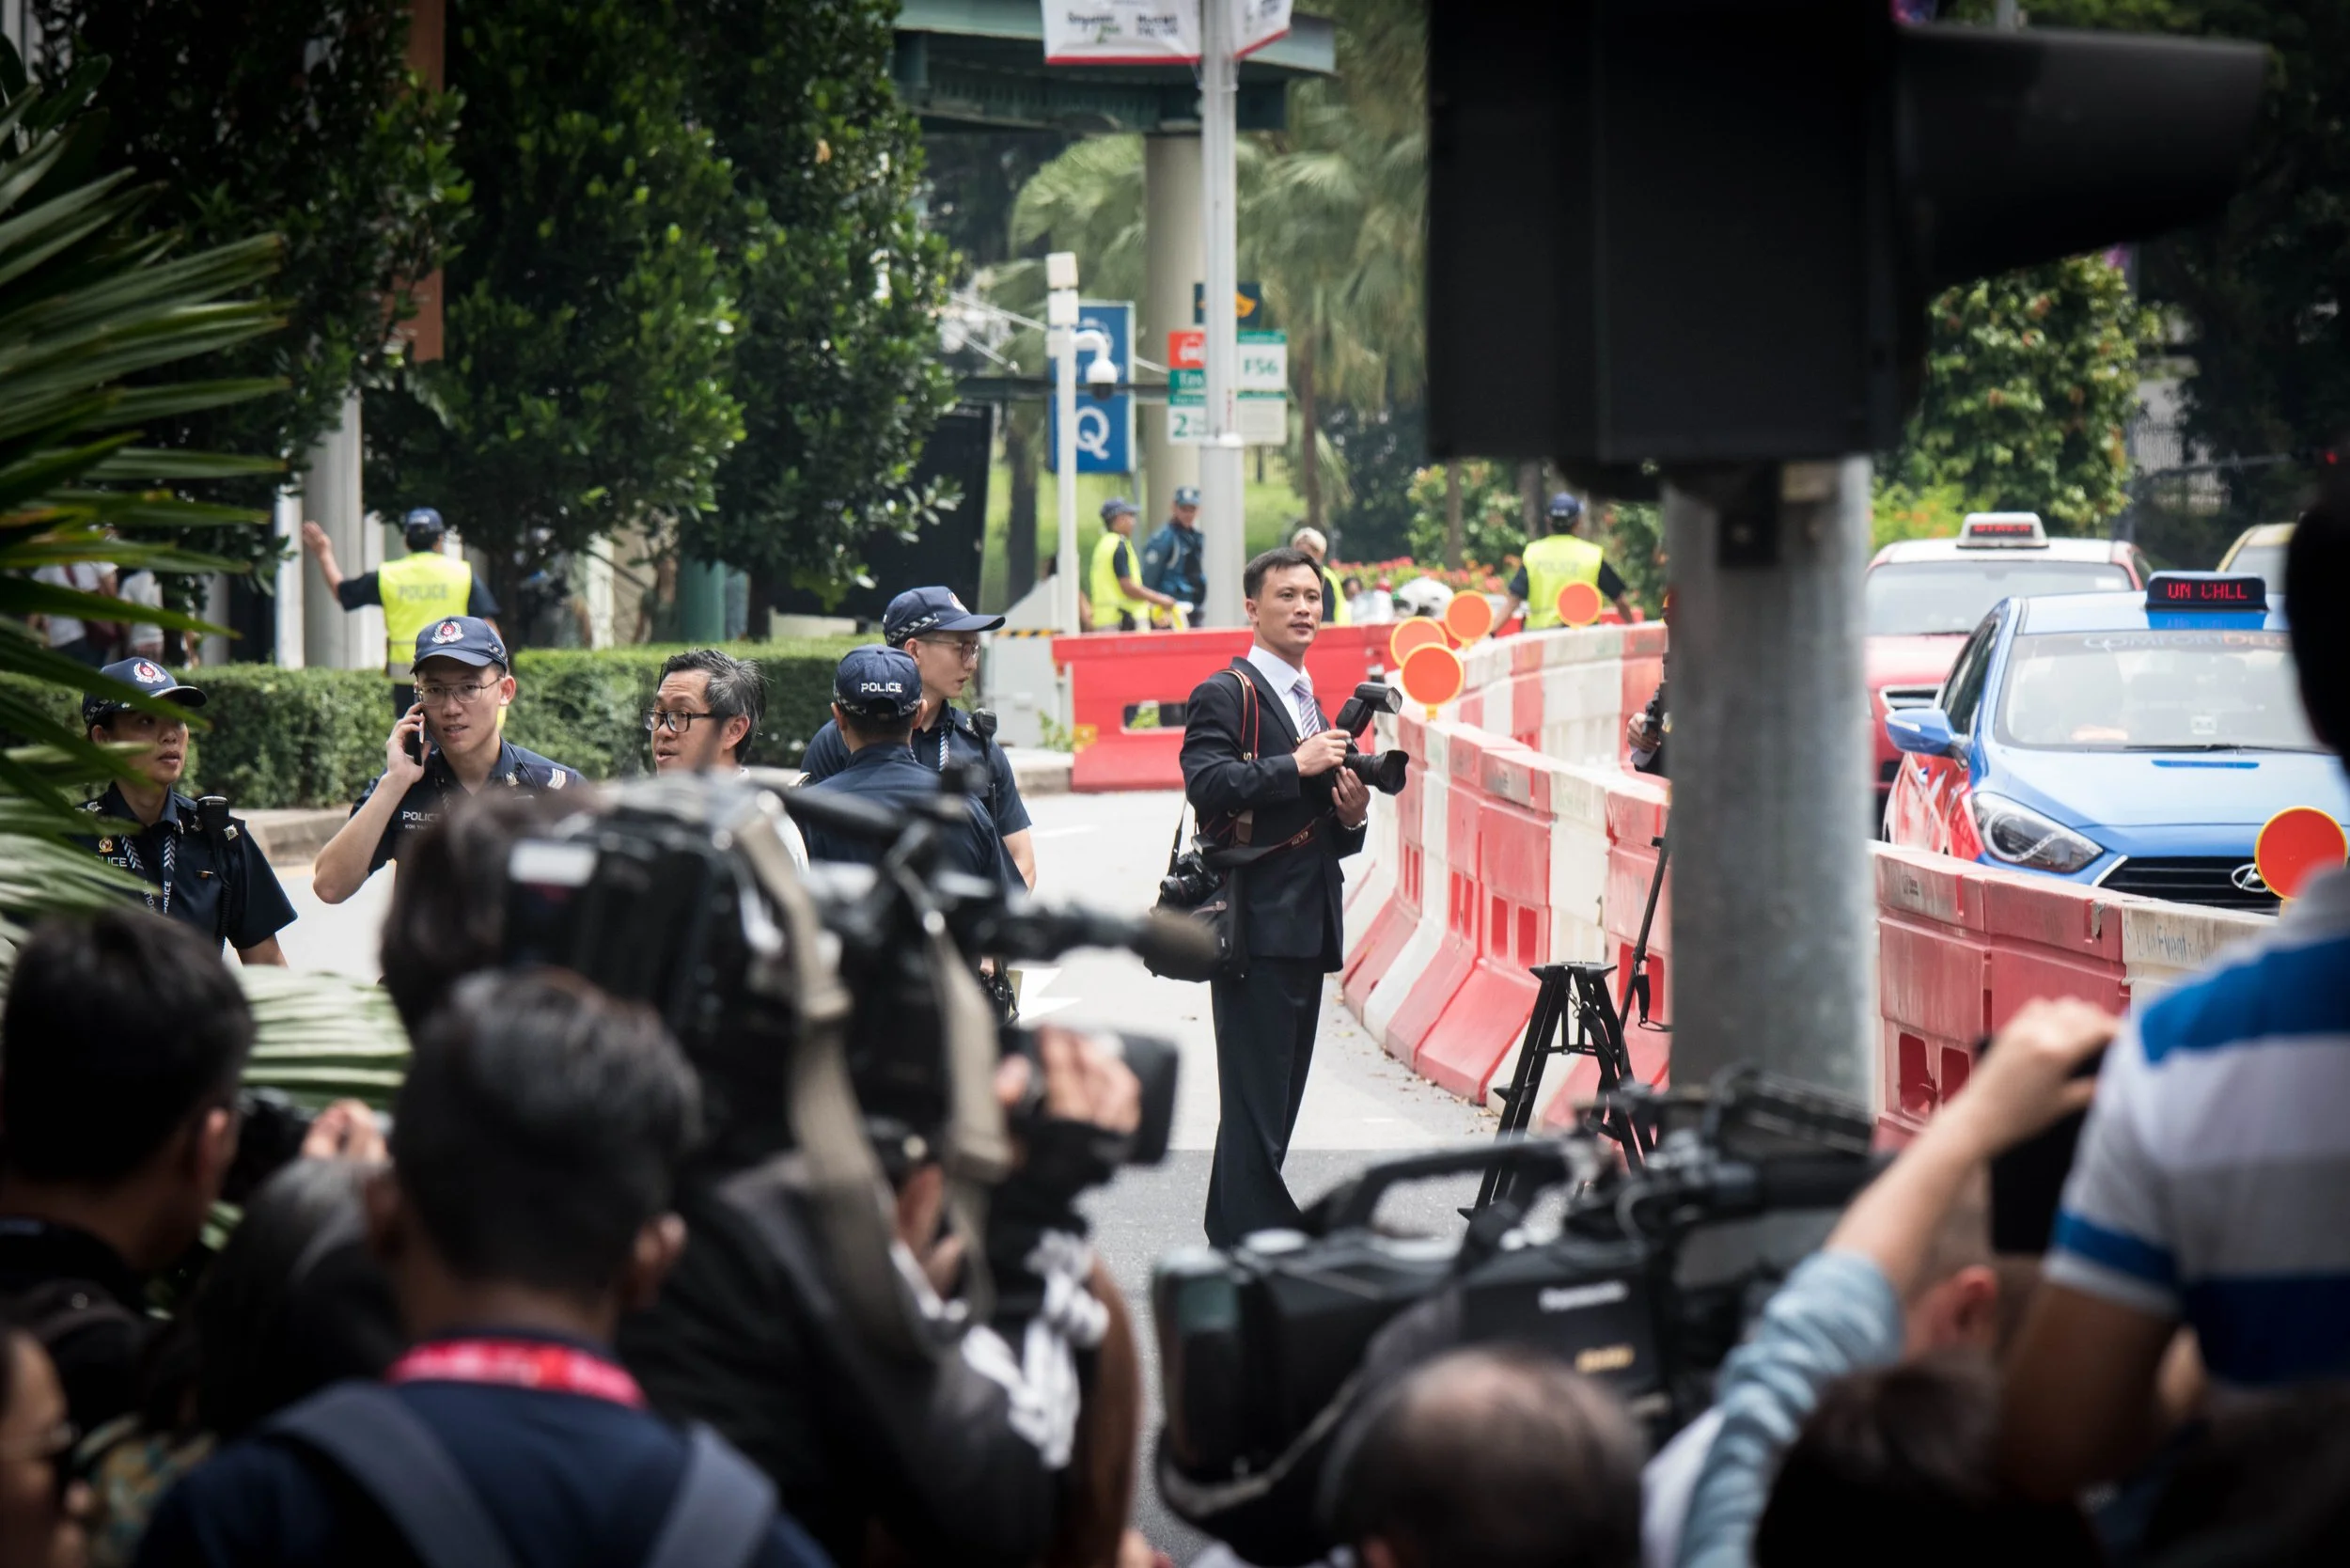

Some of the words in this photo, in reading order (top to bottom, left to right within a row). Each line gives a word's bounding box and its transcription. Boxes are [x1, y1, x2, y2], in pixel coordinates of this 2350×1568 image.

[1076, 406, 1110, 460] Q
[1173, 414, 1188, 437] 2
[399, 583, 449, 601] POLICE
[860, 682, 902, 693] POLICE
